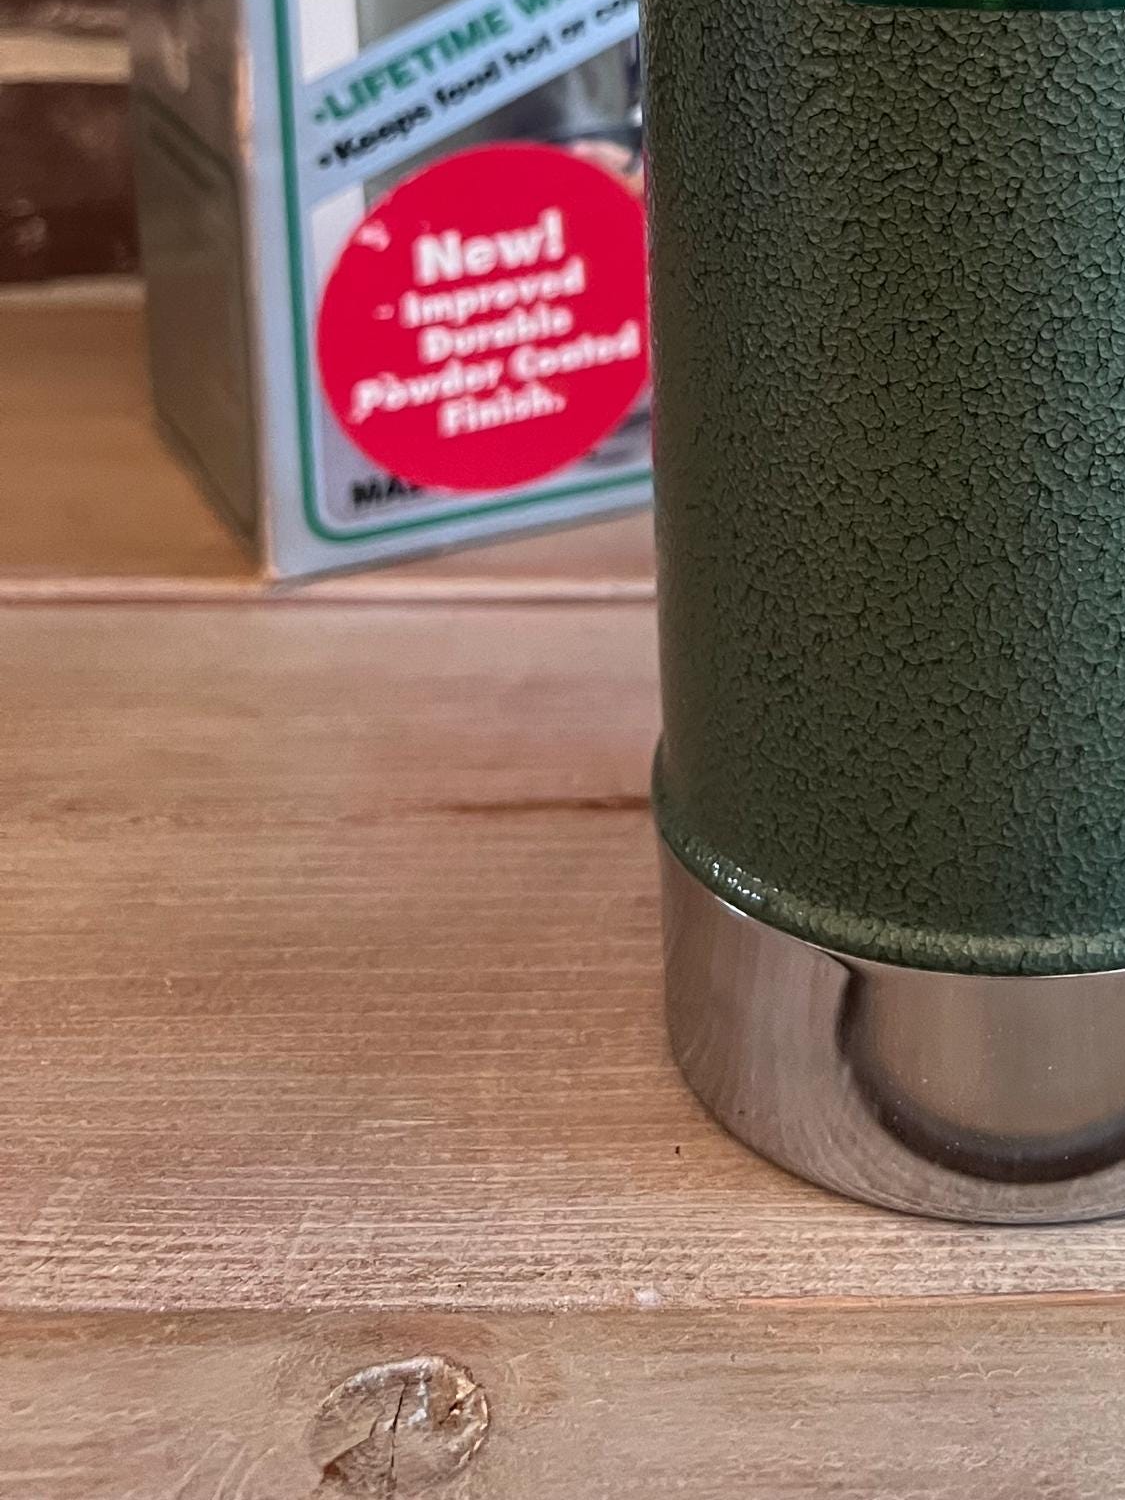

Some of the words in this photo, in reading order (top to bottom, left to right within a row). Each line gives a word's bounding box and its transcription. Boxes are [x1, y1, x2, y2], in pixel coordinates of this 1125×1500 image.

[322, 8, 509, 121] LIFETIME
[413, 206, 565, 286] New!
[400, 256, 586, 328] Improved
[351, 359, 502, 425] Powder
[507, 319, 641, 381] Coated
[419, 303, 573, 364] Durable
